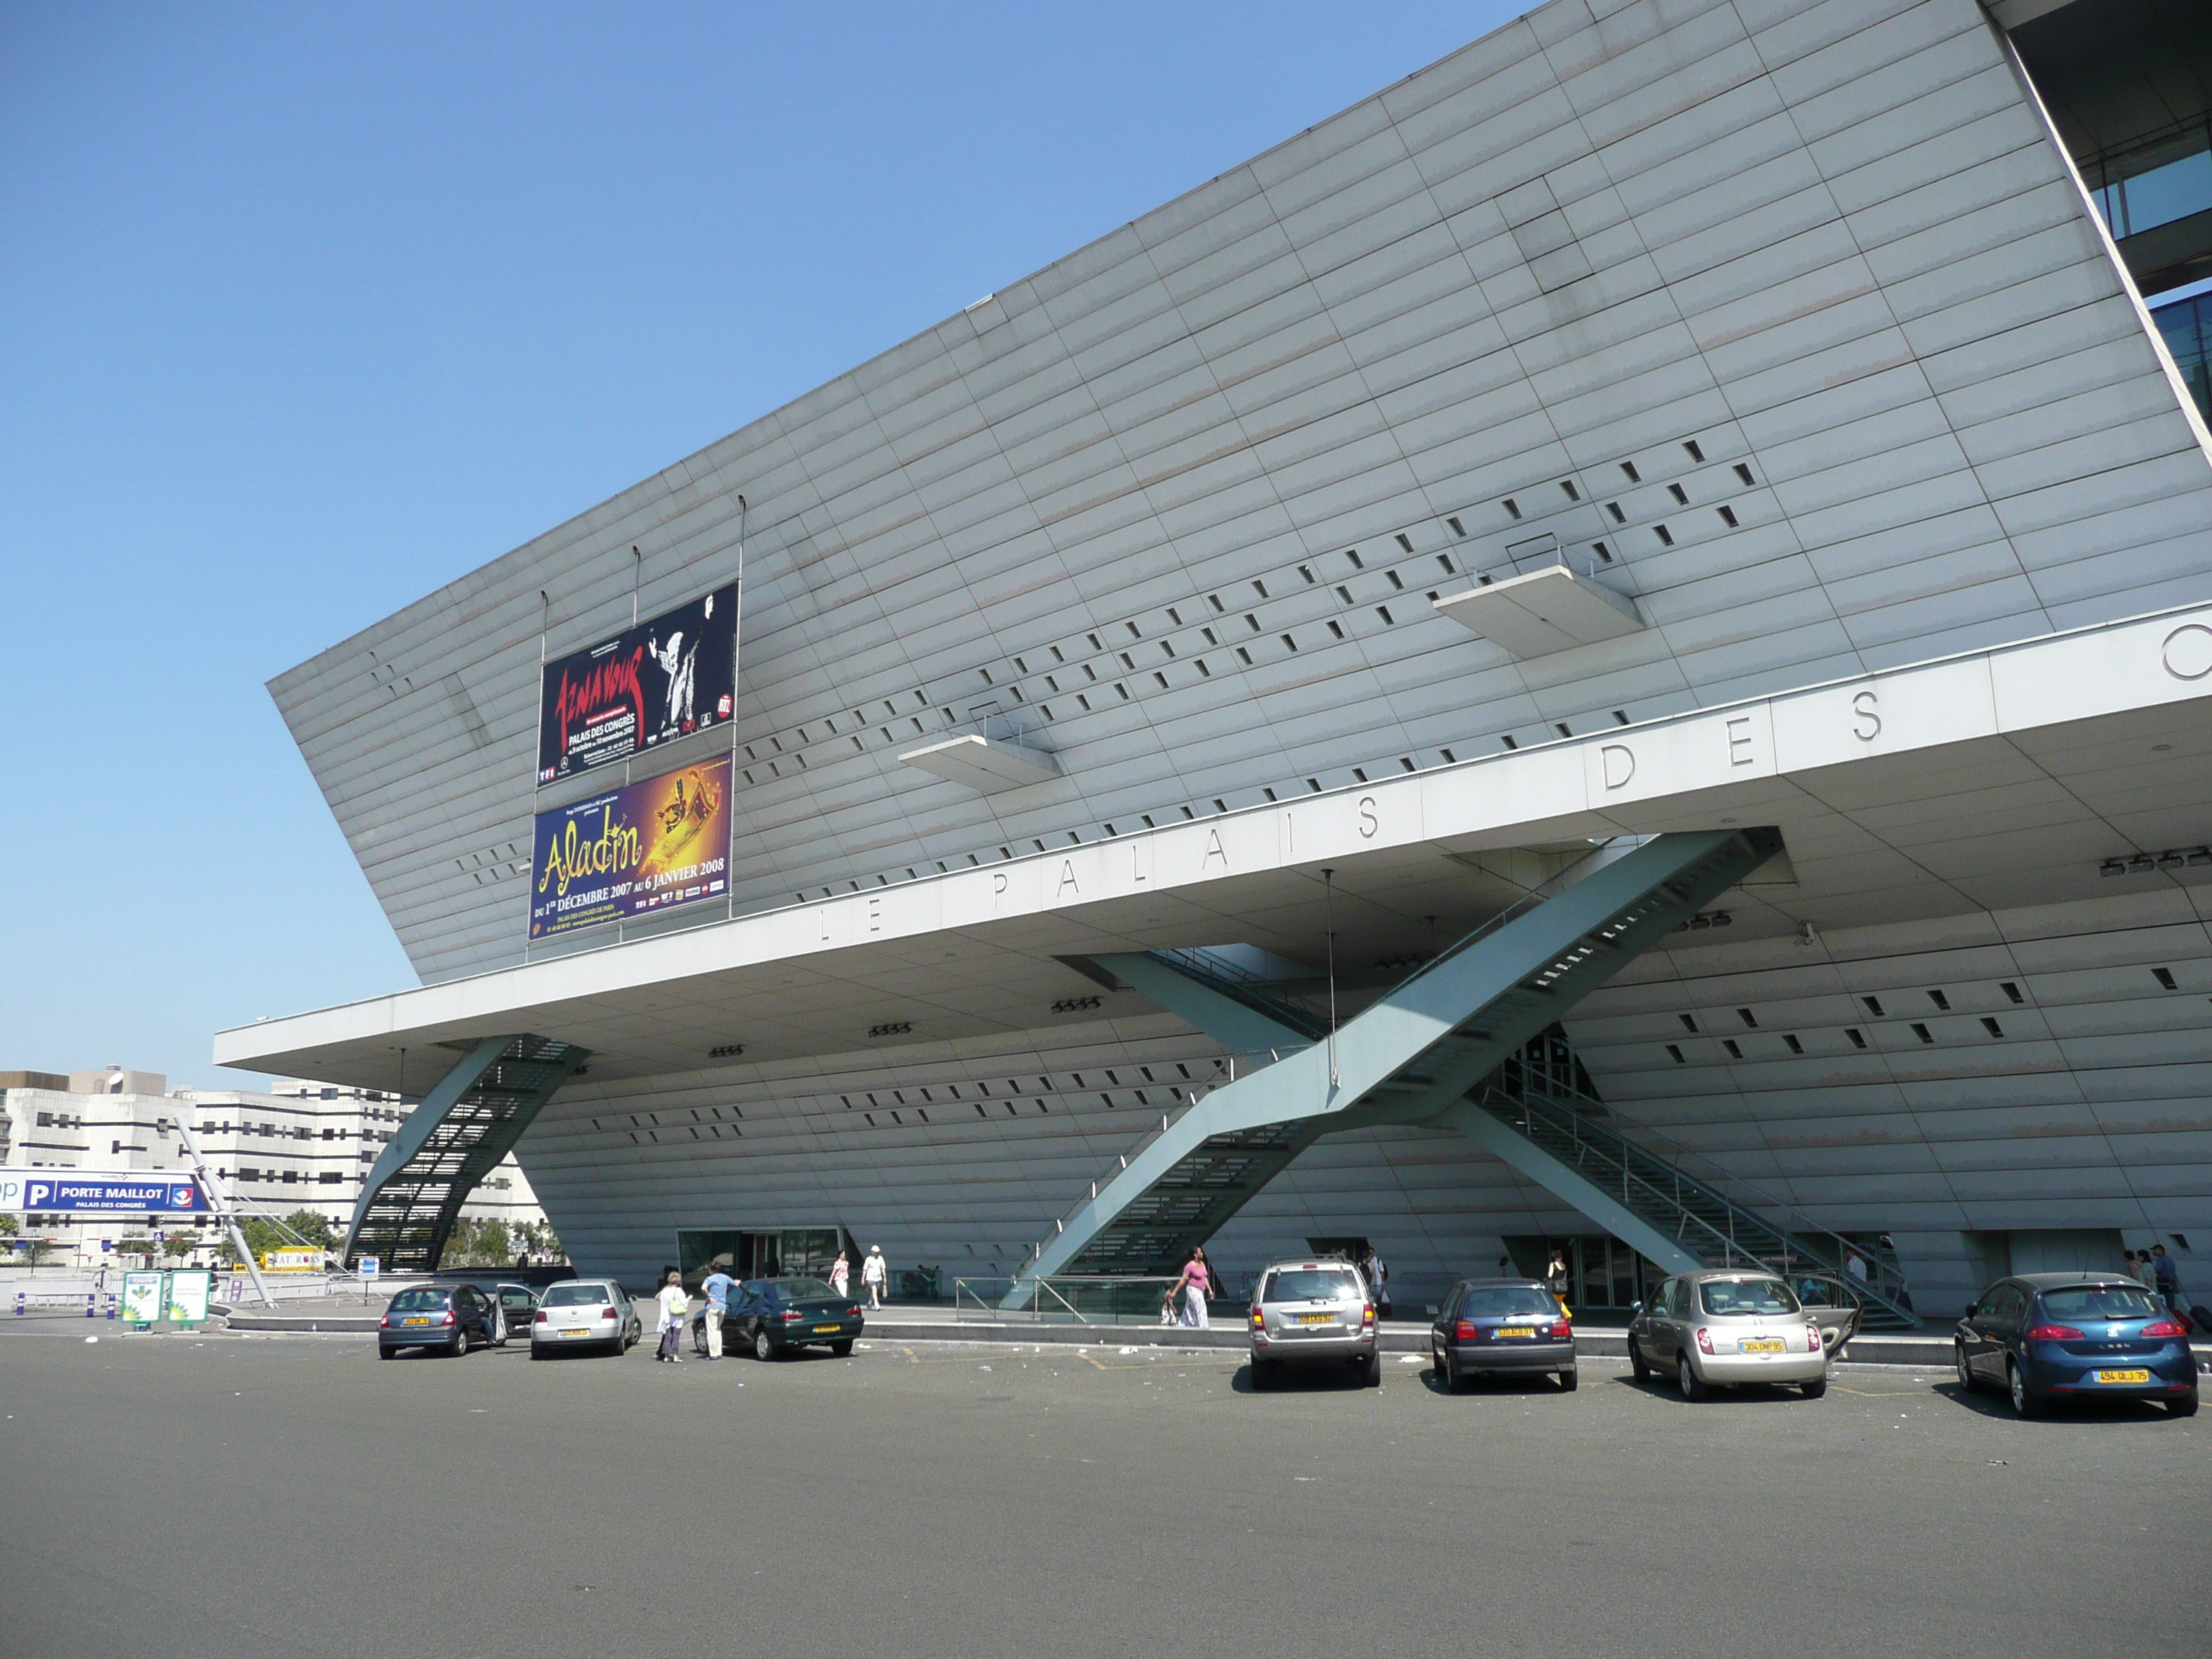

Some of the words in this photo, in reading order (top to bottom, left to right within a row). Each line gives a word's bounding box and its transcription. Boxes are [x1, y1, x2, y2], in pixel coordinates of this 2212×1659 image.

[554, 645, 644, 755] AZNAVOUR
[569, 729, 590, 746] PALAIS
[591, 724, 603, 739] DES
[604, 712, 635, 732] CONGRÈS
[601, 729, 624, 743] novembre
[819, 898, 880, 941] LE
[993, 796, 1379, 909] PALAIS
[1600, 691, 1884, 792] DES
[539, 804, 642, 896] Aladin
[535, 907, 545, 917] DU
[557, 886, 609, 912] DÉCEMBRE
[611, 881, 633, 899] 2007
[634, 882, 644, 893] AU
[645, 876, 652, 889] 6
[652, 865, 698, 891] JANVIER
[699, 858, 724, 876] 2008
[30, 1184, 49, 1205] P
[60, 1187, 103, 1199] PORTE
[105, 1188, 163, 1199] MAILLOT
[2100, 1371, 2116, 1380] 494
[2136, 1371, 2147, 1380] 75
